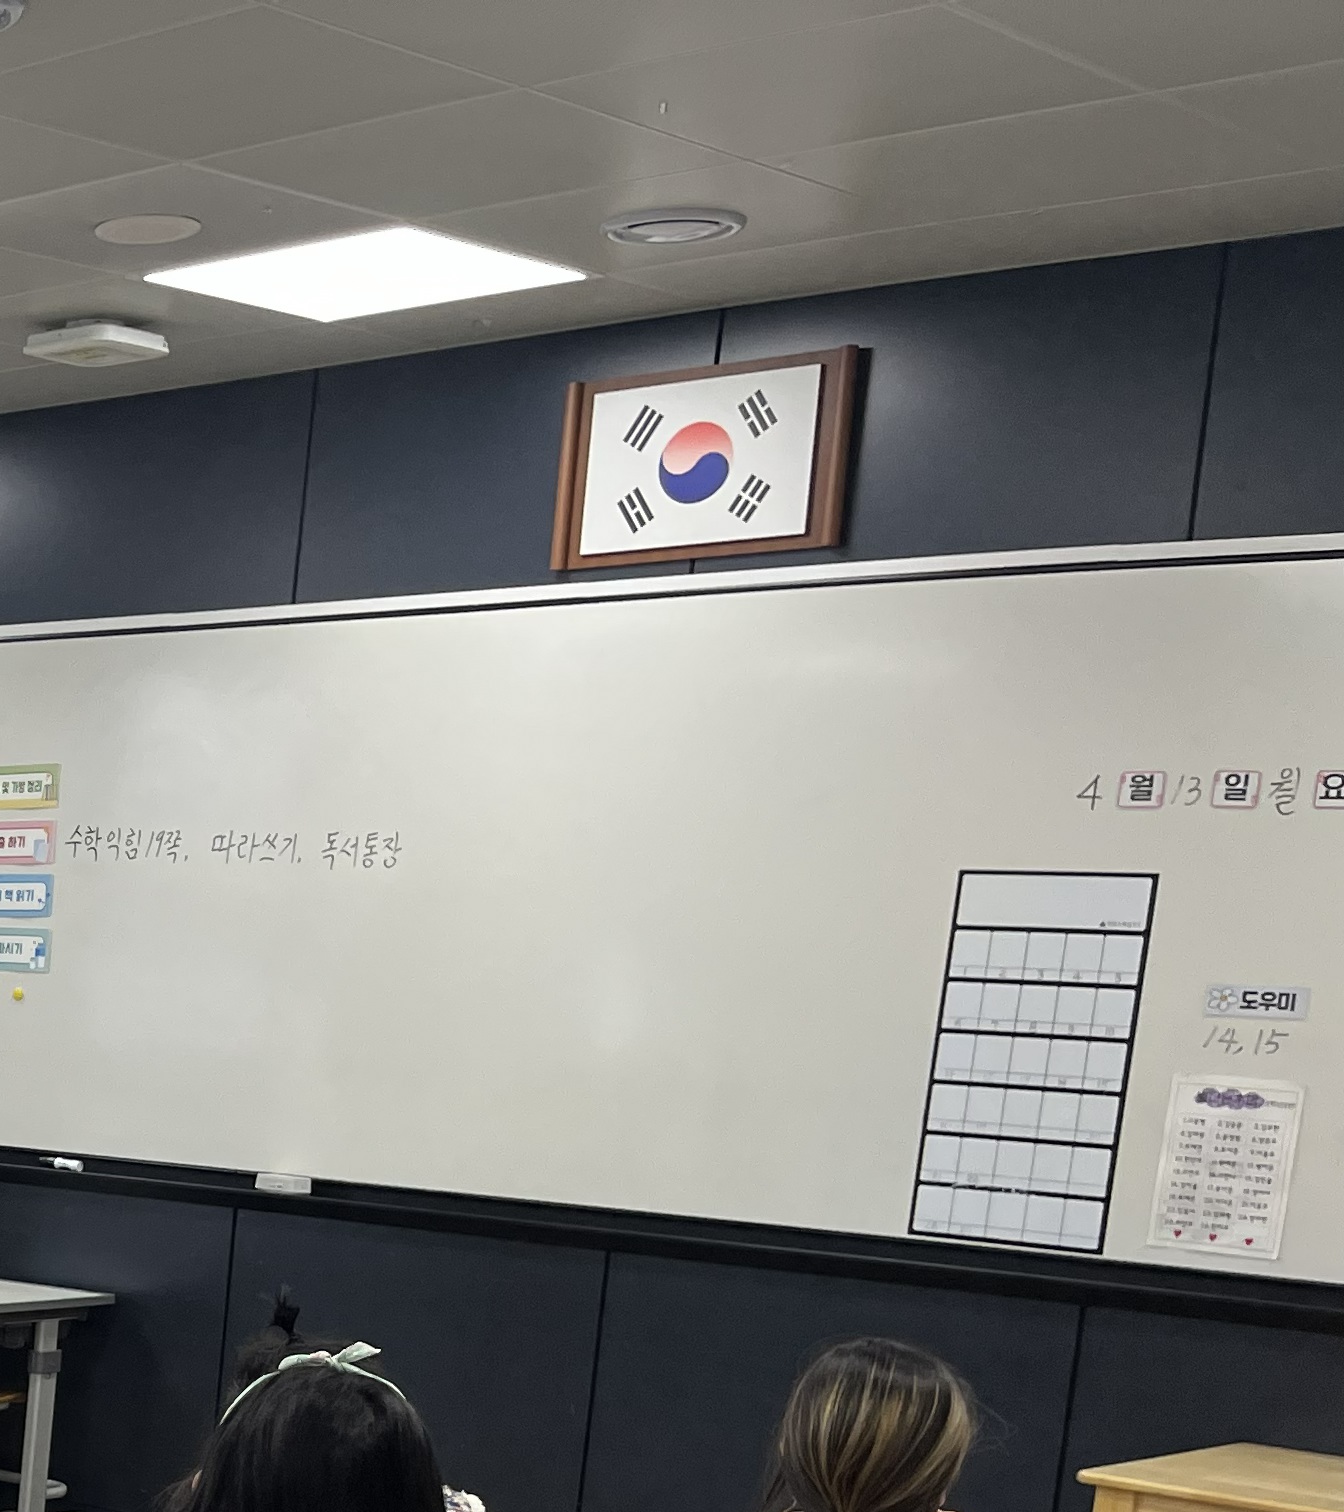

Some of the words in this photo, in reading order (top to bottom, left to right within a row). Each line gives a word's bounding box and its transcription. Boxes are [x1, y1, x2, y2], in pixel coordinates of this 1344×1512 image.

[1075, 773, 1103, 811] 4
[1128, 773, 1155, 802] 월
[1170, 774, 1203, 807] 13
[1223, 773, 1250, 801] 일
[1318, 773, 1344, 800] 요
[8, 835, 26, 849] 하기
[321, 831, 402, 870] 독서통장
[4, 889, 14, 902] 책
[16, 889, 35, 902] 읽기
[1239, 989, 1298, 1012] 도우미
[1254, 1028, 1290, 1056] 15
